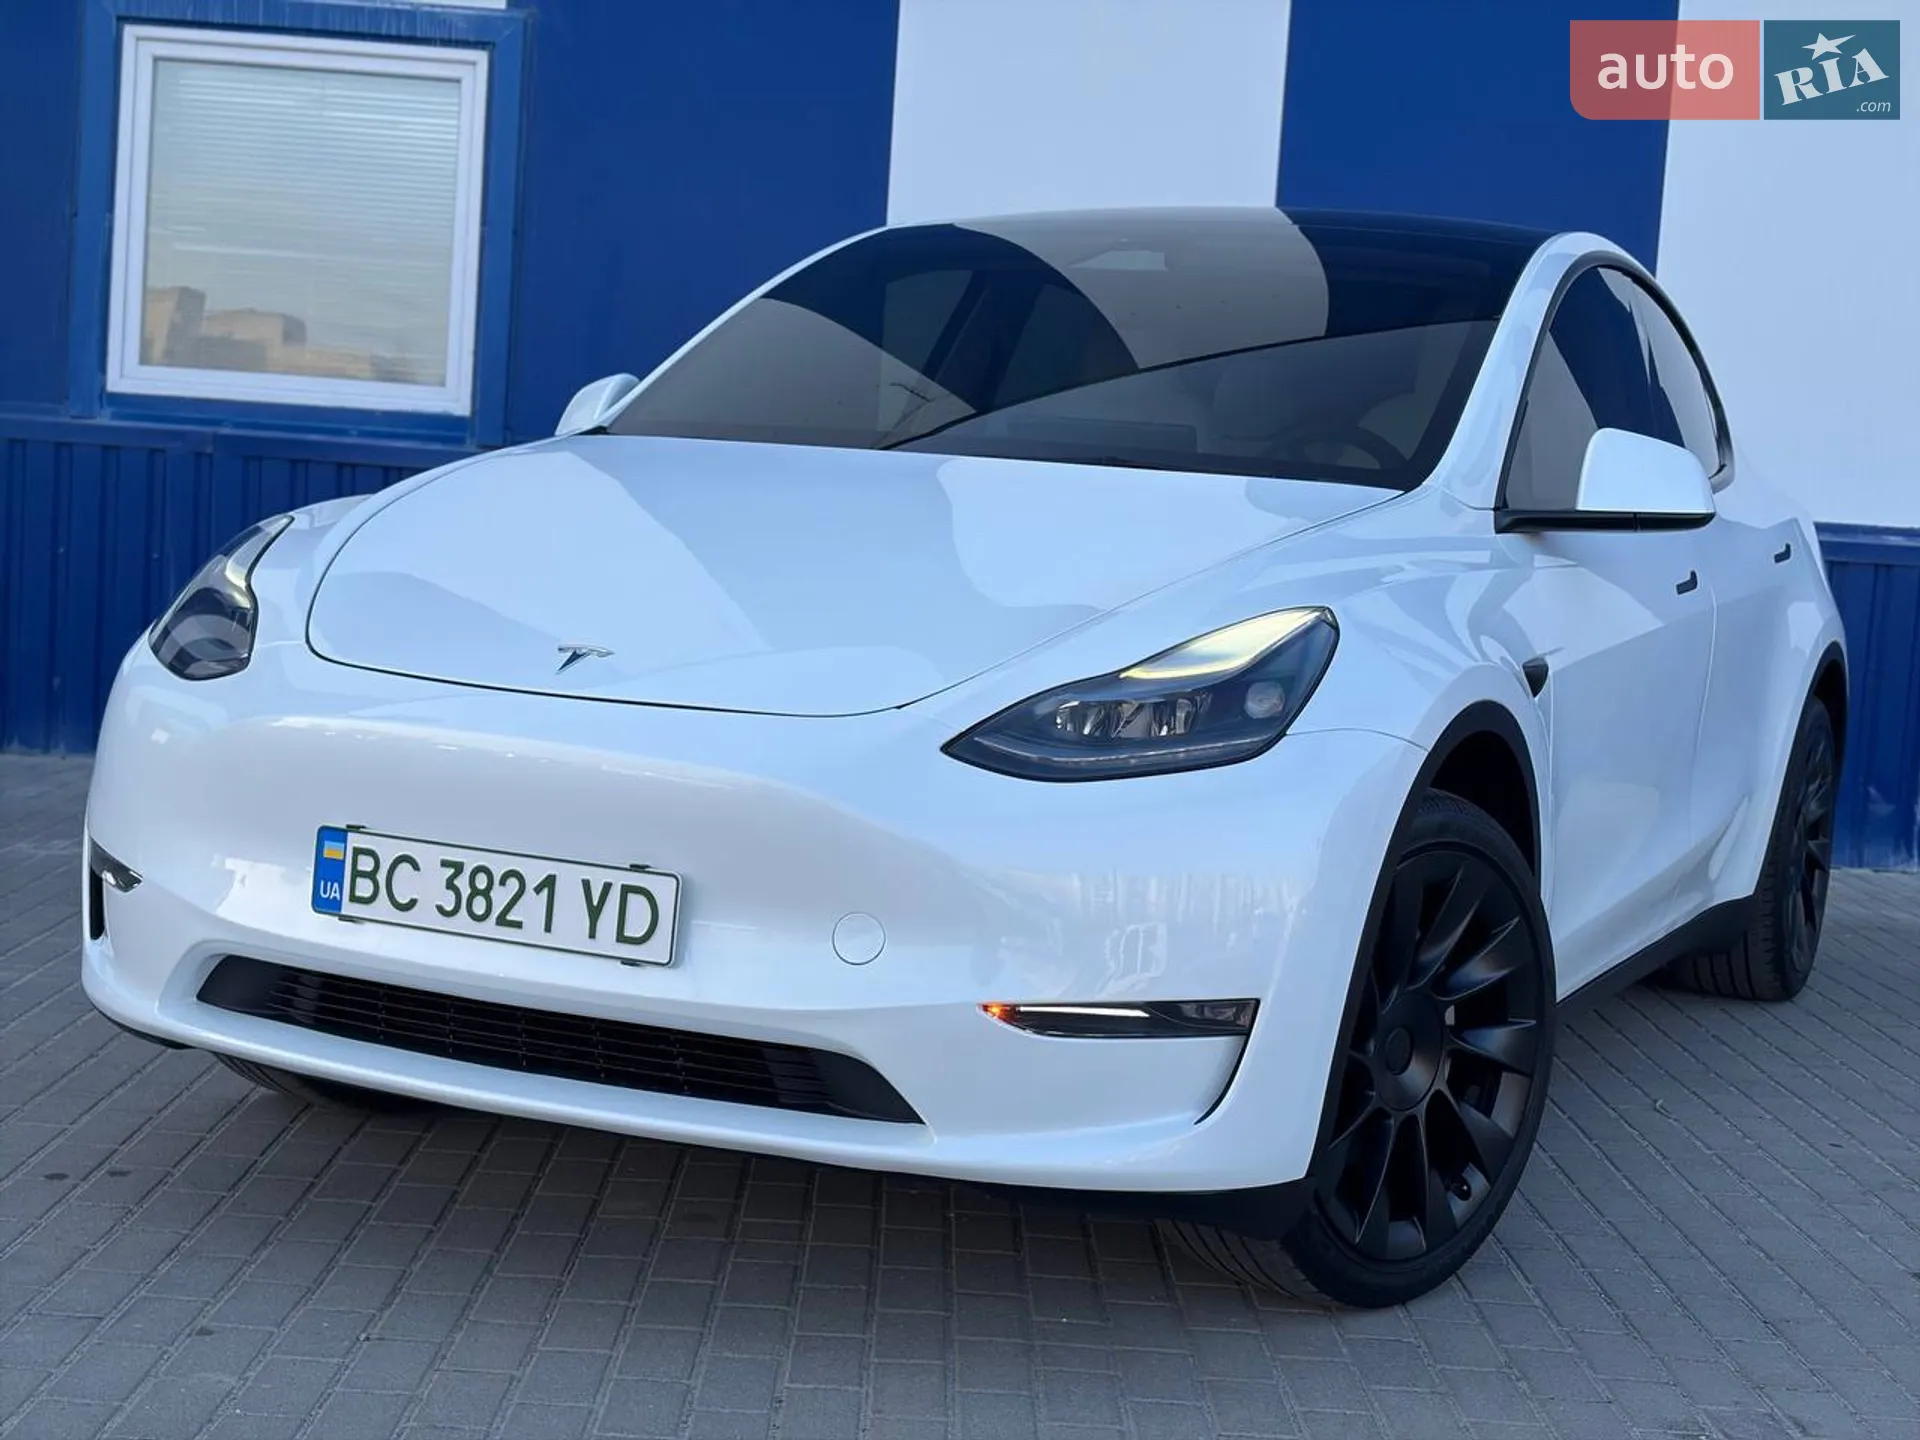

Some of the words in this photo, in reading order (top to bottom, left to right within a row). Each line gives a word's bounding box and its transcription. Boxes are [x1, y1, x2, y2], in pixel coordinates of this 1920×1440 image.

[319, 880, 341, 901] UA
[348, 845, 422, 912] BC
[435, 858, 557, 933] 3821
[580, 878, 660, 946] YD
